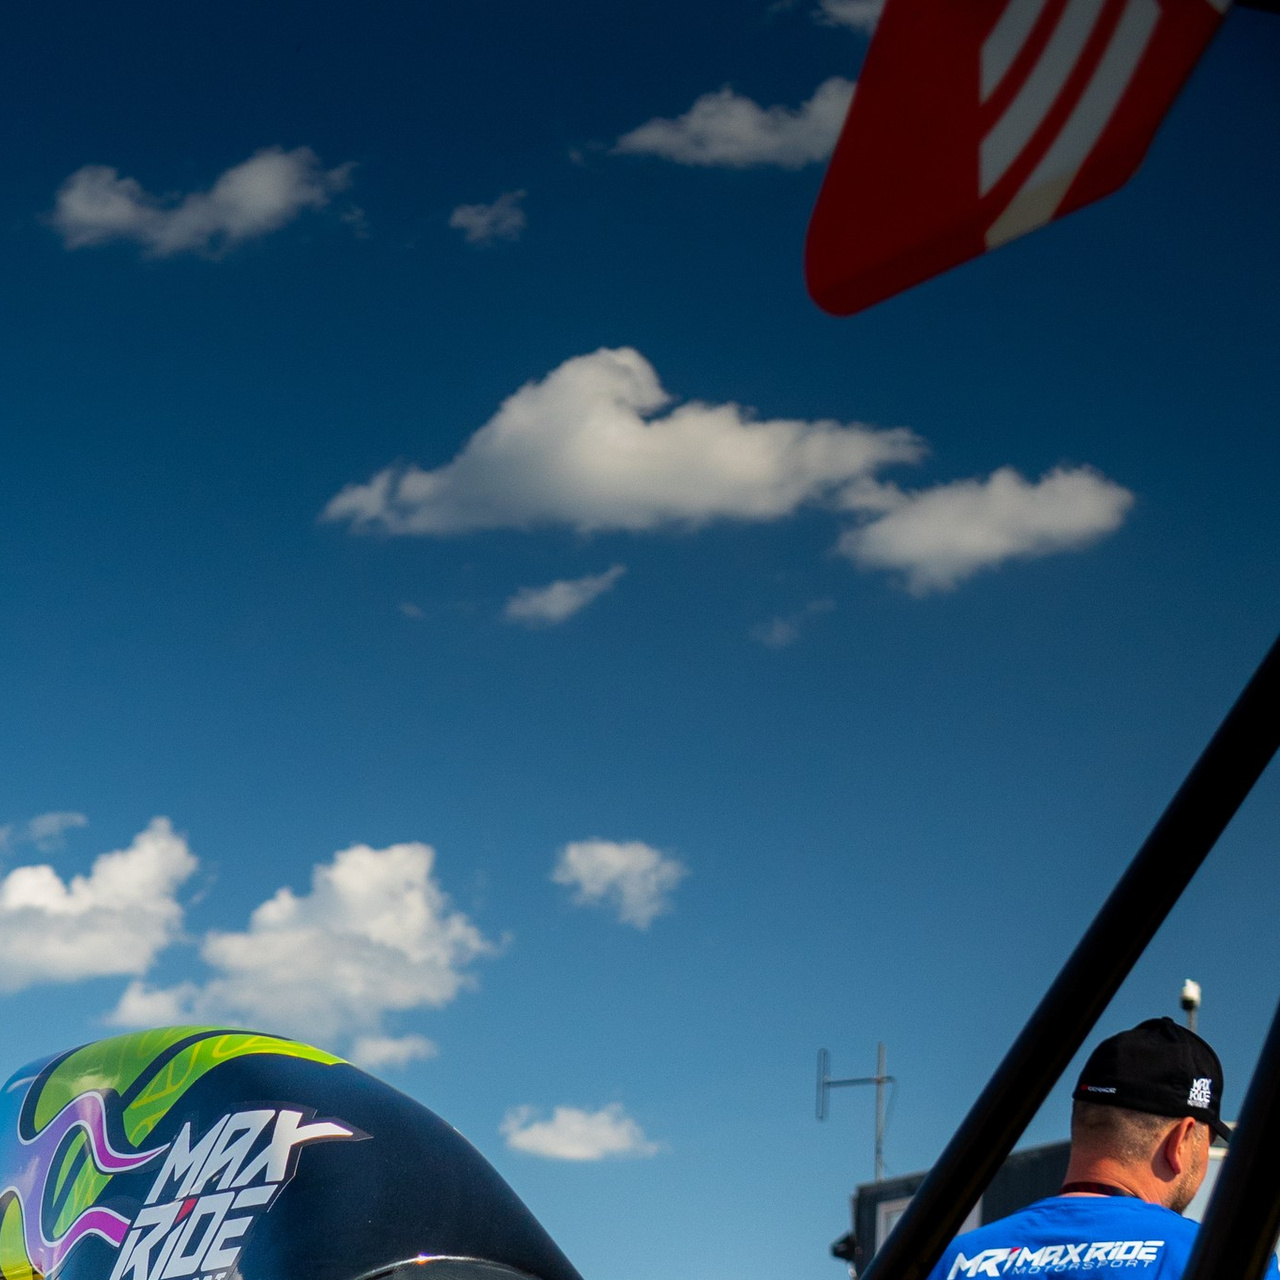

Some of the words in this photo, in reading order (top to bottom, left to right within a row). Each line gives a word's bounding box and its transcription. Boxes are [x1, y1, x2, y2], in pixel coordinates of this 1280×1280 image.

[144, 1109, 353, 1205] MAX
[1011, 1259, 1154, 1275] MOTORSPORT
[1015, 1243, 1088, 1267] MAX
[1083, 1240, 1165, 1262] RIDE
